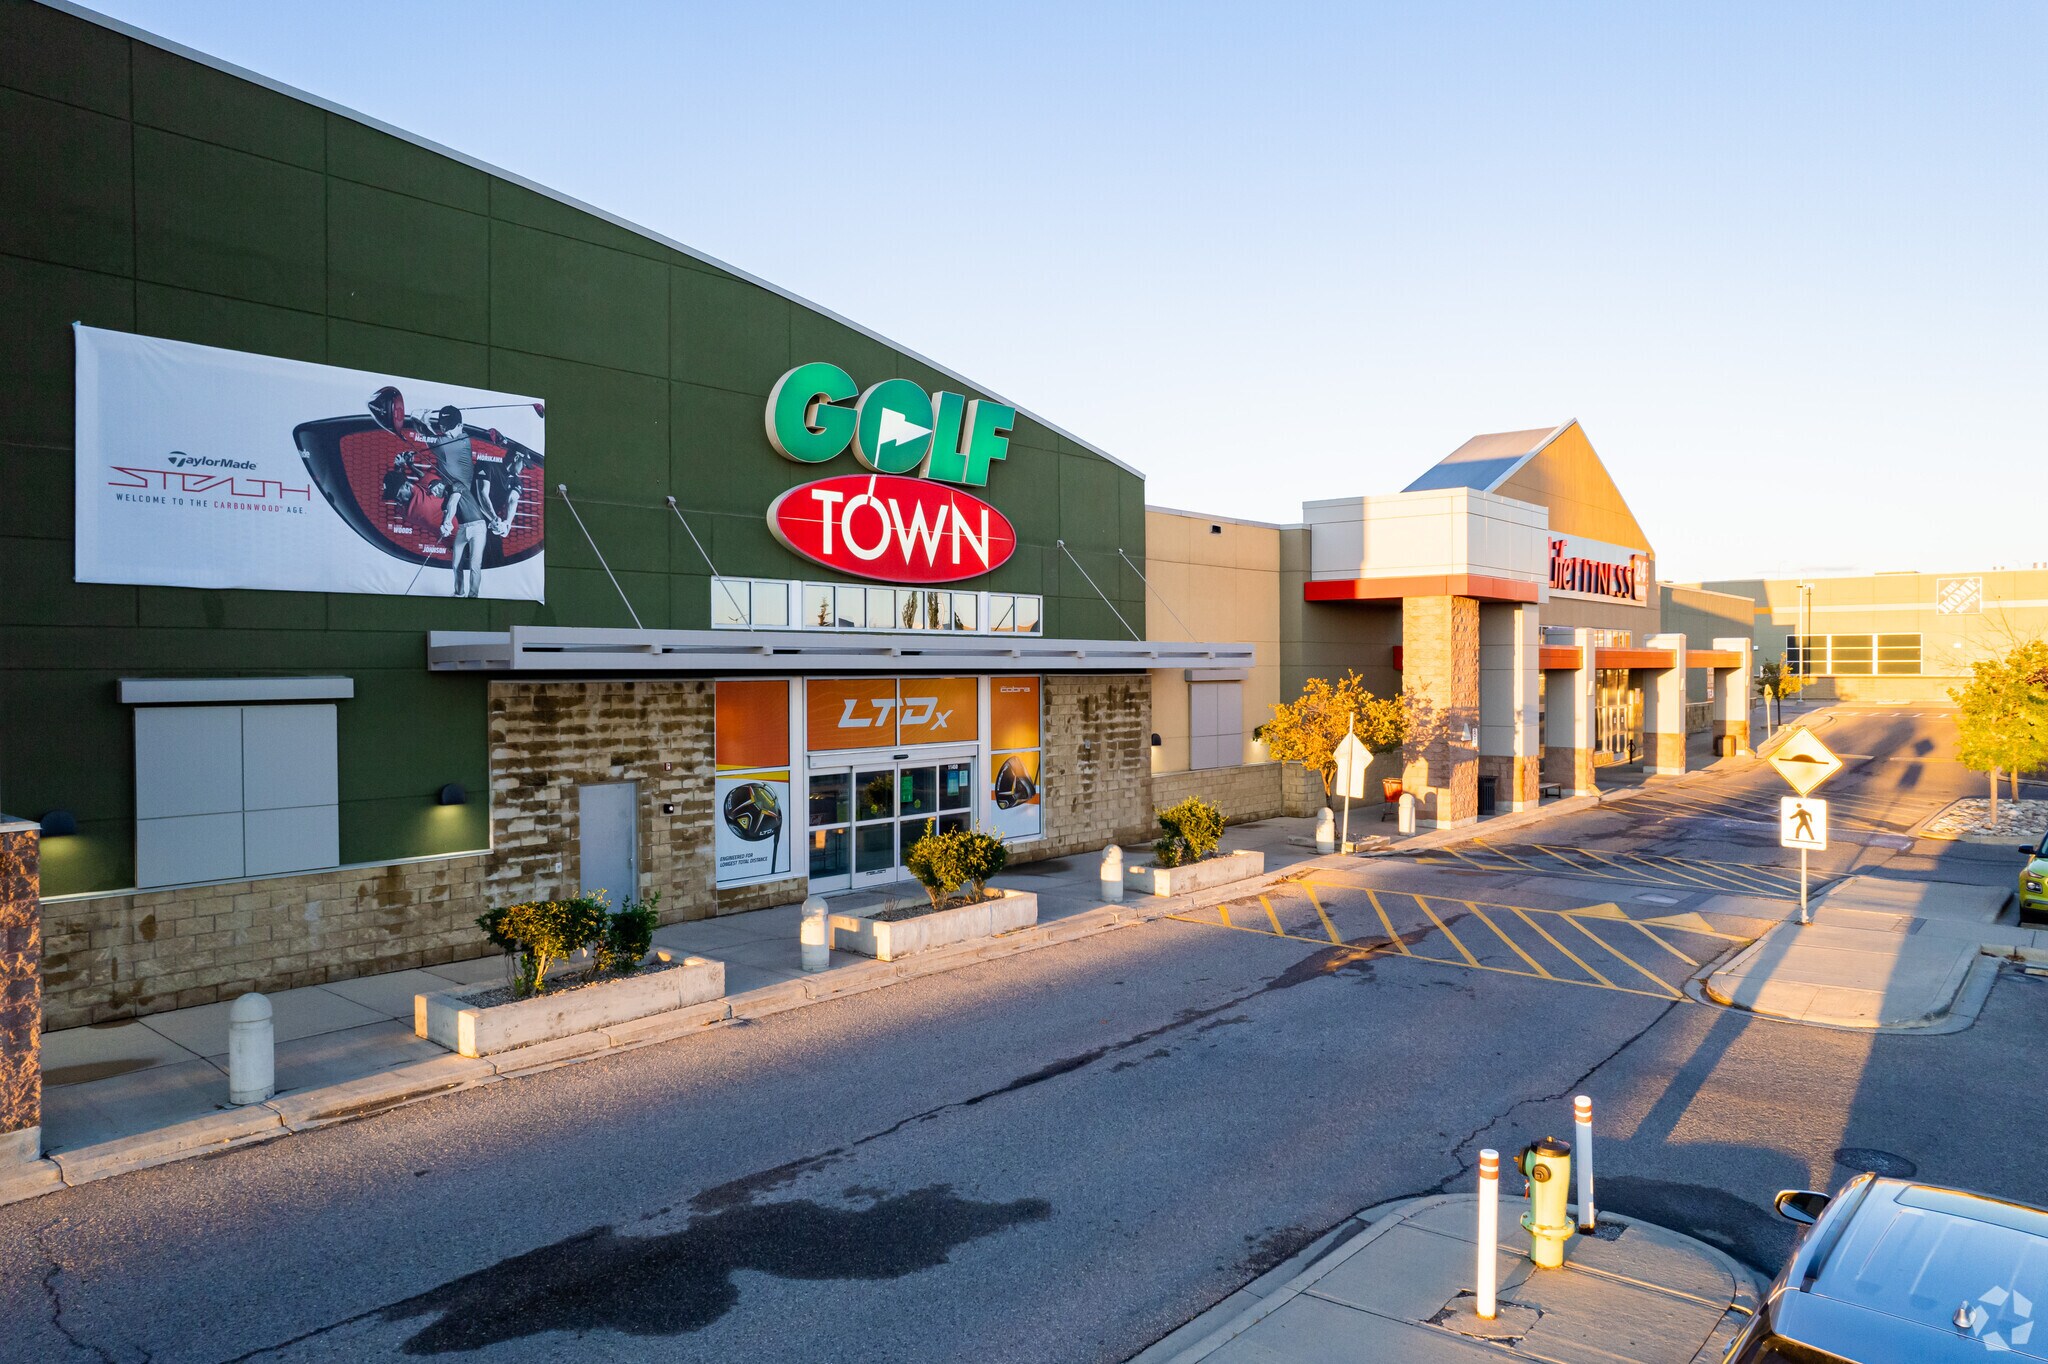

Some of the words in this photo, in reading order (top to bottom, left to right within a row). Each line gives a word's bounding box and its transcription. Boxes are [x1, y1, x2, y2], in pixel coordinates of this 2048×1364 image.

[765, 361, 1016, 487] GOLF
[168, 451, 257, 471] TaylorMade
[108, 465, 310, 501] STEALTH
[116, 493, 166, 504] WELCOME
[172, 497, 184, 506] TO
[190, 499, 208, 508] THE
[811, 488, 989, 570] TOWN
[1636, 560, 1646, 582] 24
[1938, 578, 1980, 614] HOME
[1940, 581, 1960, 597] THE
[1955, 592, 1980, 614] DEPOT
[719, 853, 745, 862] ENGINEERED
[750, 856, 768, 864] DISTANCE
